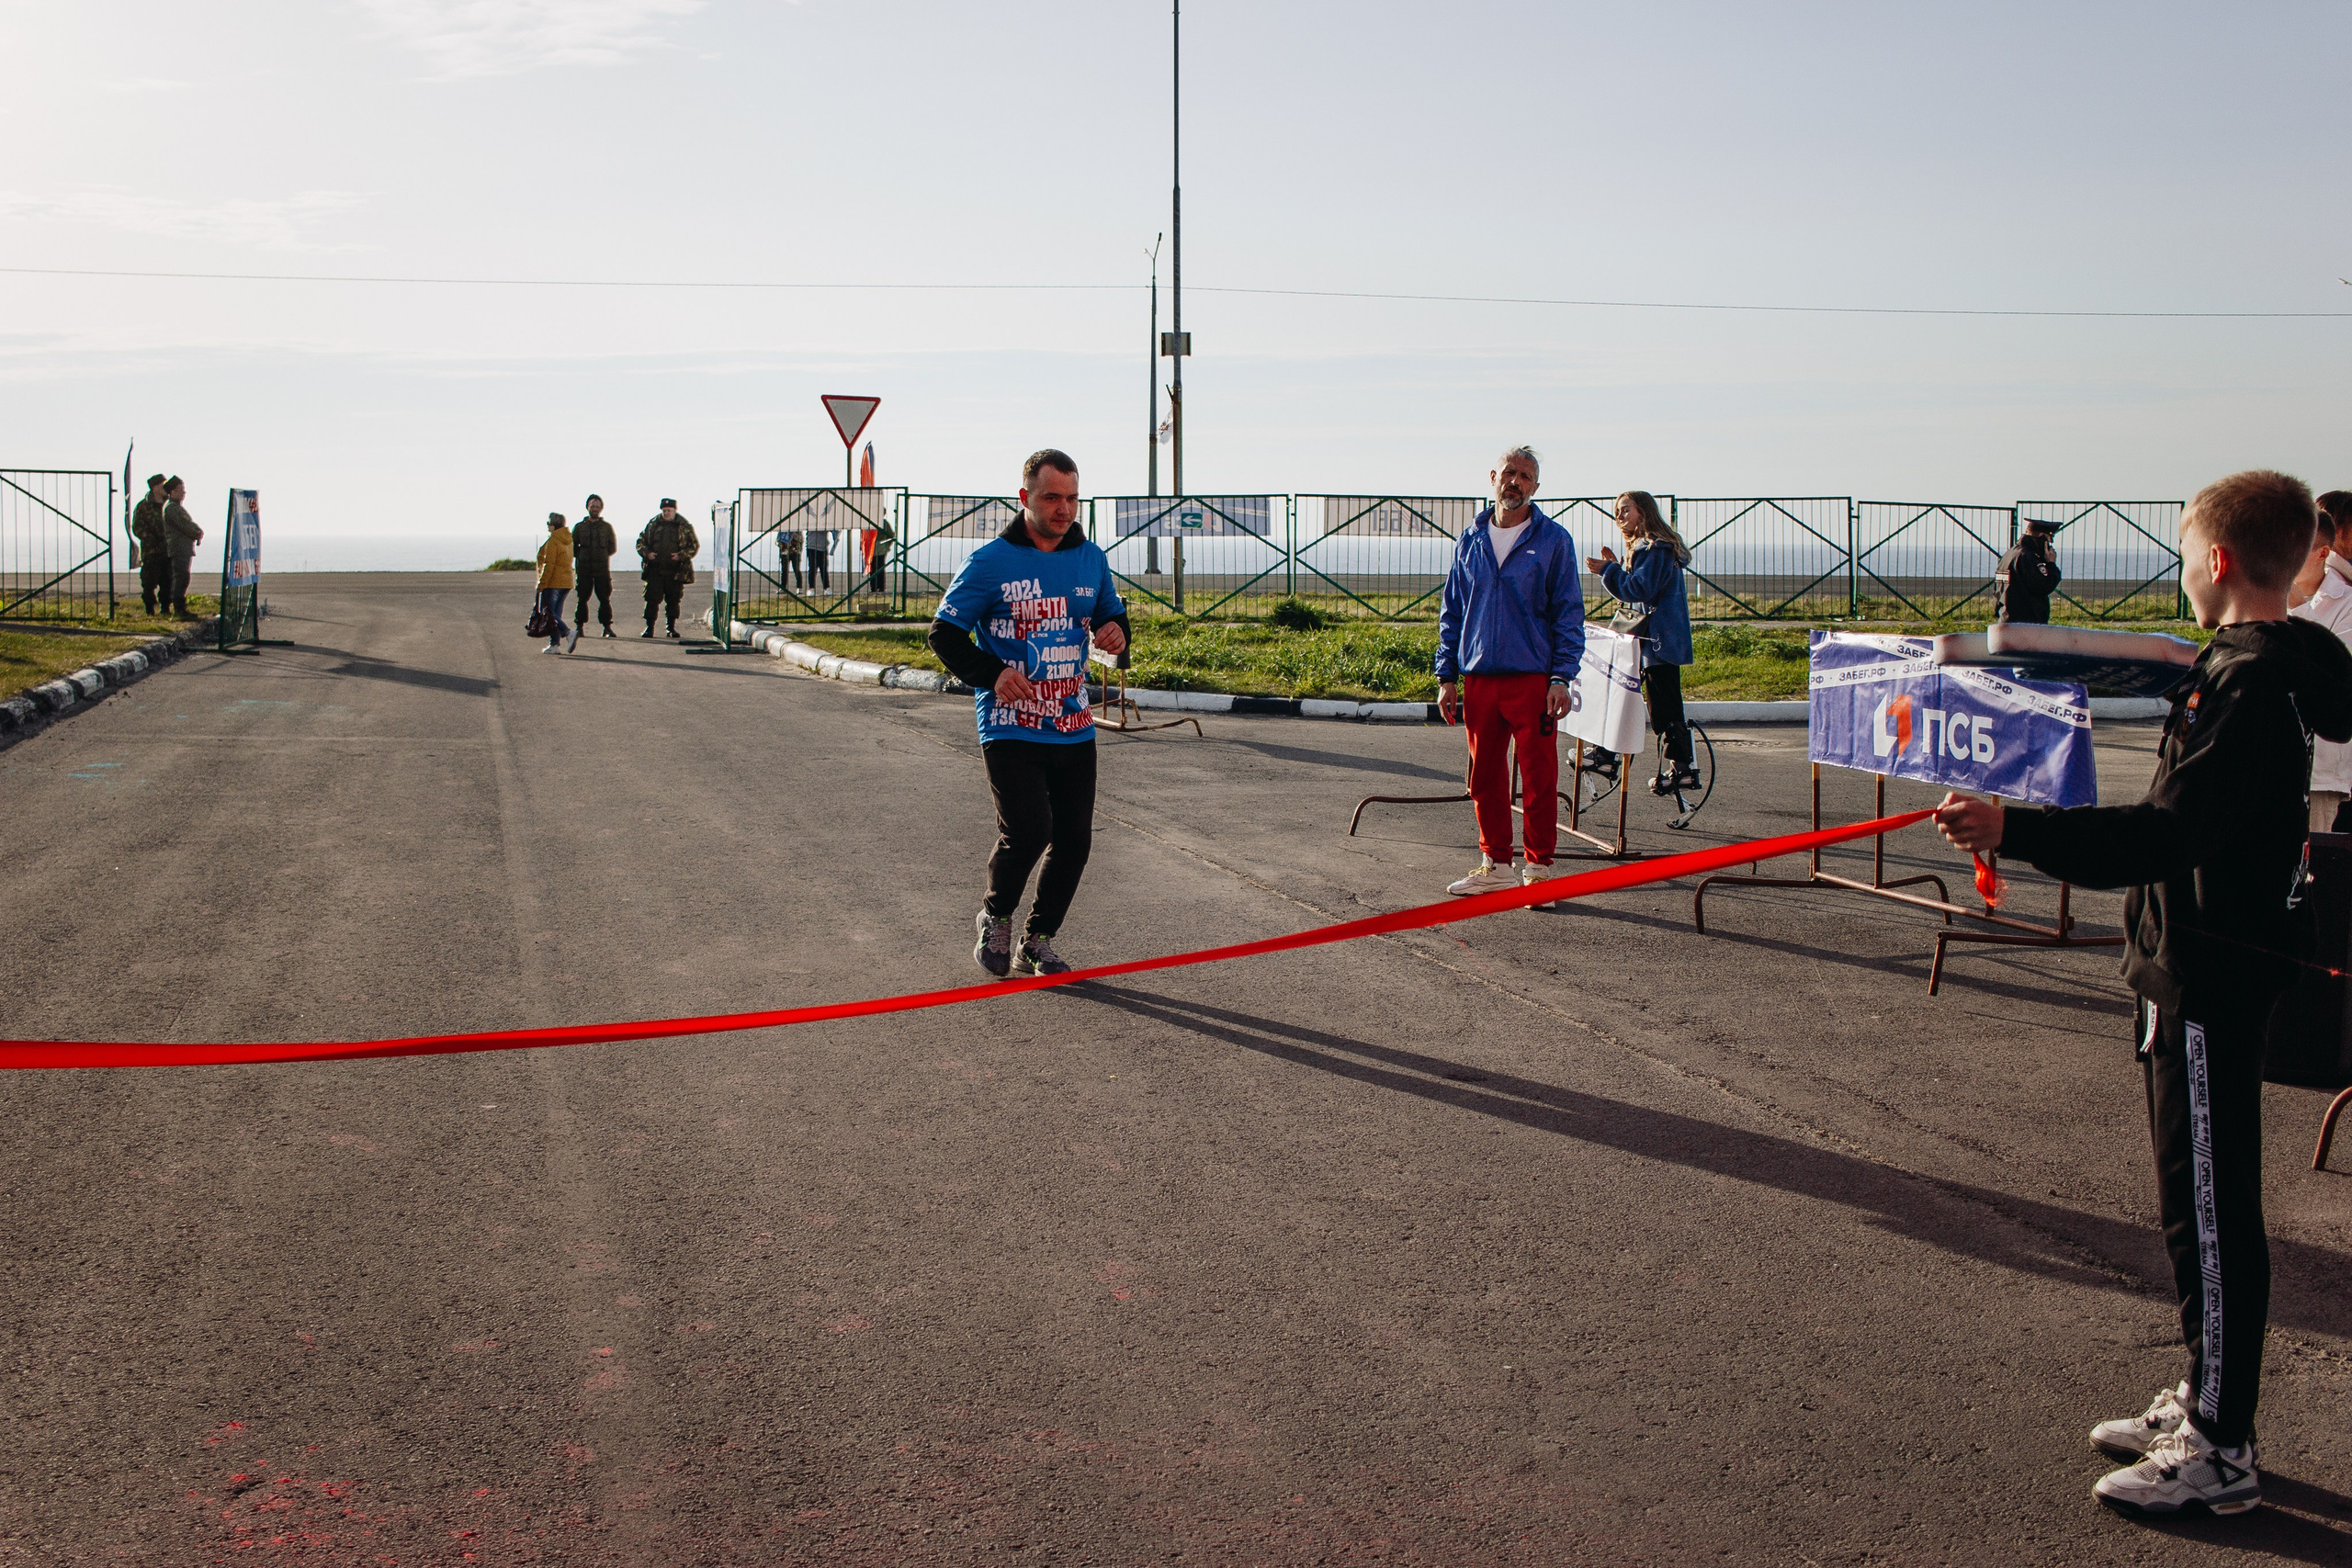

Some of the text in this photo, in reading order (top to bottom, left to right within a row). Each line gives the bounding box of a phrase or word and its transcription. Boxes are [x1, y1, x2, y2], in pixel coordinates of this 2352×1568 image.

[1001, 578, 1043, 603] 2024
[1011, 597, 1068, 620] #МЕЧТА
[1041, 645, 1080, 662] 40006
[1838, 667, 1886, 682] ЗАБЕГ.РФ
[1962, 670, 2087, 723] ЗАБЕГ.РФ ЗАБЕГ.РФ
[1922, 708, 1996, 764] ПСБ
[2193, 1034, 2204, 1060] OPEN
[2196, 1061, 2207, 1108] YOURSELF
[2200, 1161, 2211, 1187] OPEN
[2203, 1189, 2215, 1235] YOURSELF
[2210, 1287, 2220, 1313] OPEN
[2211, 1313, 2221, 1359] YOURSELF
